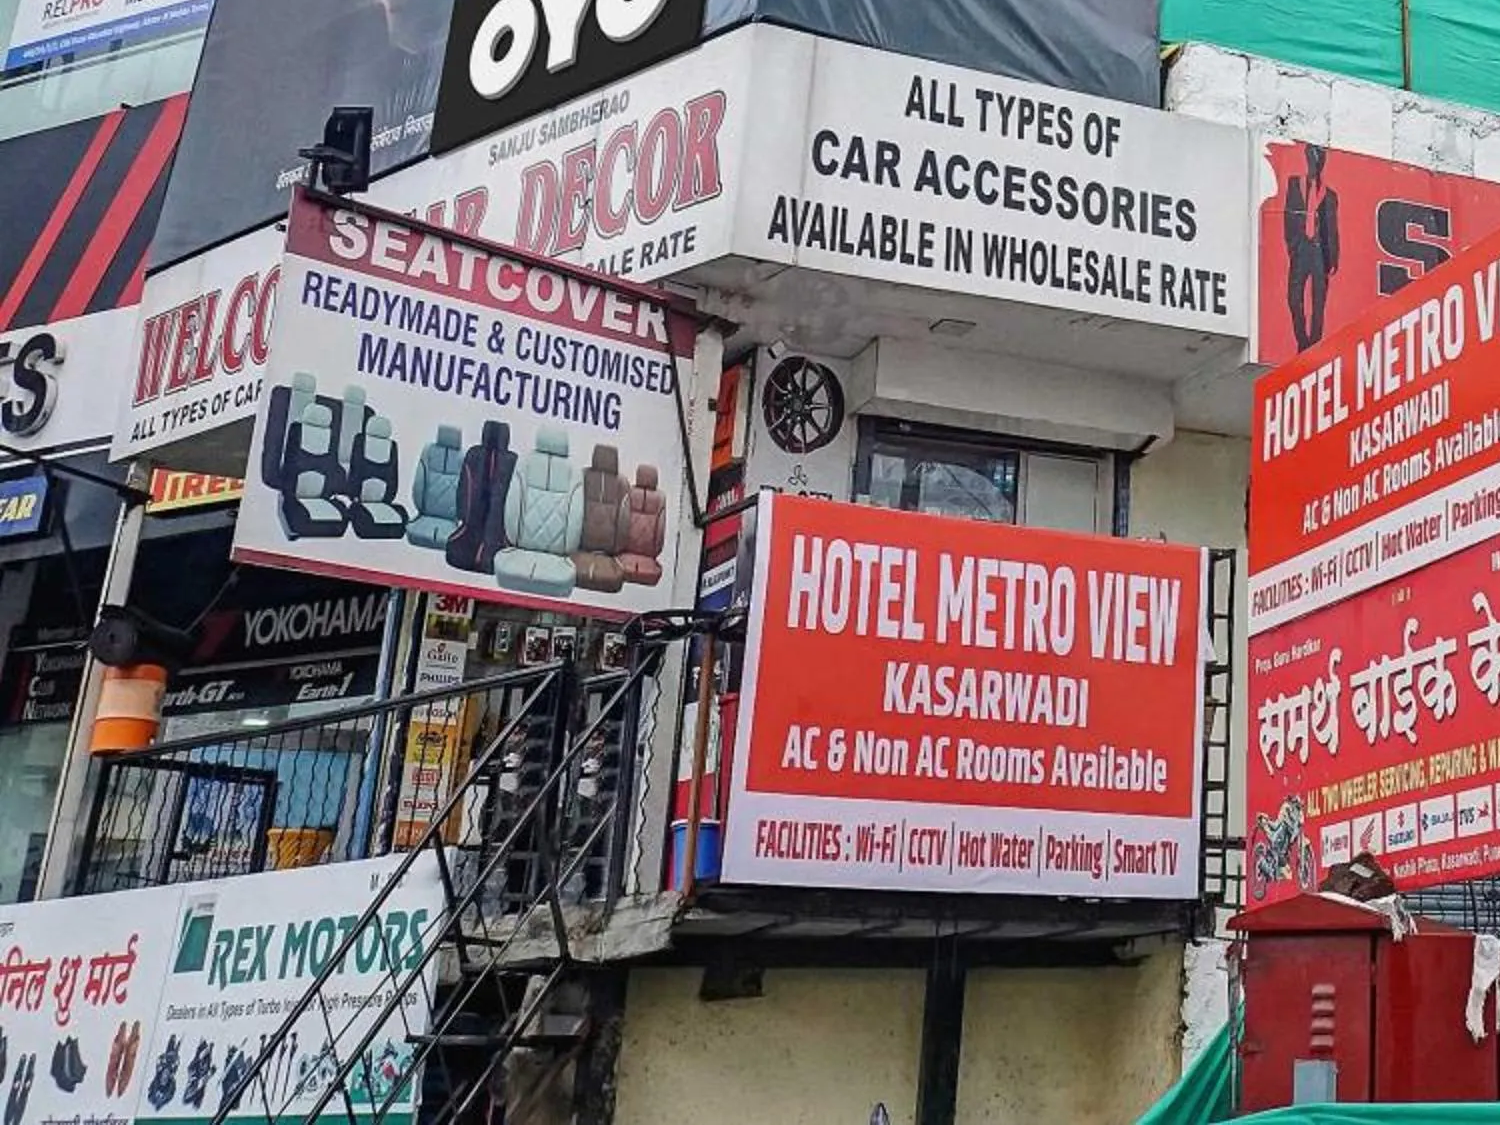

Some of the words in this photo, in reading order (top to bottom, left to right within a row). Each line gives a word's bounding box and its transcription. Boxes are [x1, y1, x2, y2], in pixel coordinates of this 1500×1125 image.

[487, 131, 536, 166] SANJU
[538, 89, 631, 153] SAMBHERAO
[905, 75, 964, 128] ALL
[975, 89, 1072, 150] TYPES
[1084, 112, 1121, 158] OF
[512, 90, 728, 259] DECOR
[811, 130, 902, 188] CAR
[914, 150, 1198, 242] ACCESSORIES
[330, 208, 670, 345] SEATCOVER
[639, 226, 697, 268] RATE
[767, 195, 936, 269] AVAILABLE
[944, 227, 973, 275] IN
[982, 232, 1151, 304] WHOLESALE
[1160, 264, 1228, 316] RATE
[302, 271, 479, 348] READYMADE
[487, 320, 506, 355] &
[516, 325, 676, 395] CUSTOMISED
[1263, 356, 1349, 462] HOTEL
[1356, 283, 1465, 411] METRO
[131, 416, 156, 443] ALL
[162, 396, 207, 428] TYPES
[211, 391, 231, 415] OF
[358, 333, 622, 430] MANUFACTURING
[1350, 379, 1450, 469] KASARWADI
[1302, 501, 1319, 535] AC
[1362, 472, 1380, 504] AC
[1344, 541, 1374, 578] CCTV
[1381, 532, 1404, 563] Hot
[1404, 512, 1443, 552] Water
[244, 592, 388, 649] YOKOHAMA
[787, 534, 925, 641] HOTEL
[936, 552, 1076, 657] METRO
[1088, 570, 1182, 666] VIEW
[882, 662, 1089, 728] KASARWADI
[1258, 647, 1343, 775] समर्थ
[1350, 618, 1457, 744] बाईक
[781, 725, 820, 770] AC
[827, 728, 847, 771] &
[853, 732, 908, 777] Non
[915, 736, 950, 780] AC
[956, 738, 1045, 785] Rooms
[1050, 745, 1167, 793] Available
[1306, 789, 1321, 818] ALL
[755, 820, 842, 862] FACILITIES
[854, 824, 897, 863] Wi-Fi
[907, 828, 948, 866] CCTV
[958, 830, 987, 868] Hot
[989, 832, 1034, 870] Water
[1045, 835, 1104, 879] Parking
[1114, 837, 1159, 874] Smart
[1160, 841, 1179, 876] TV
[207, 923, 277, 992] REX
[277, 908, 429, 981] MOTORS
[220, 1001, 246, 1023] Types
